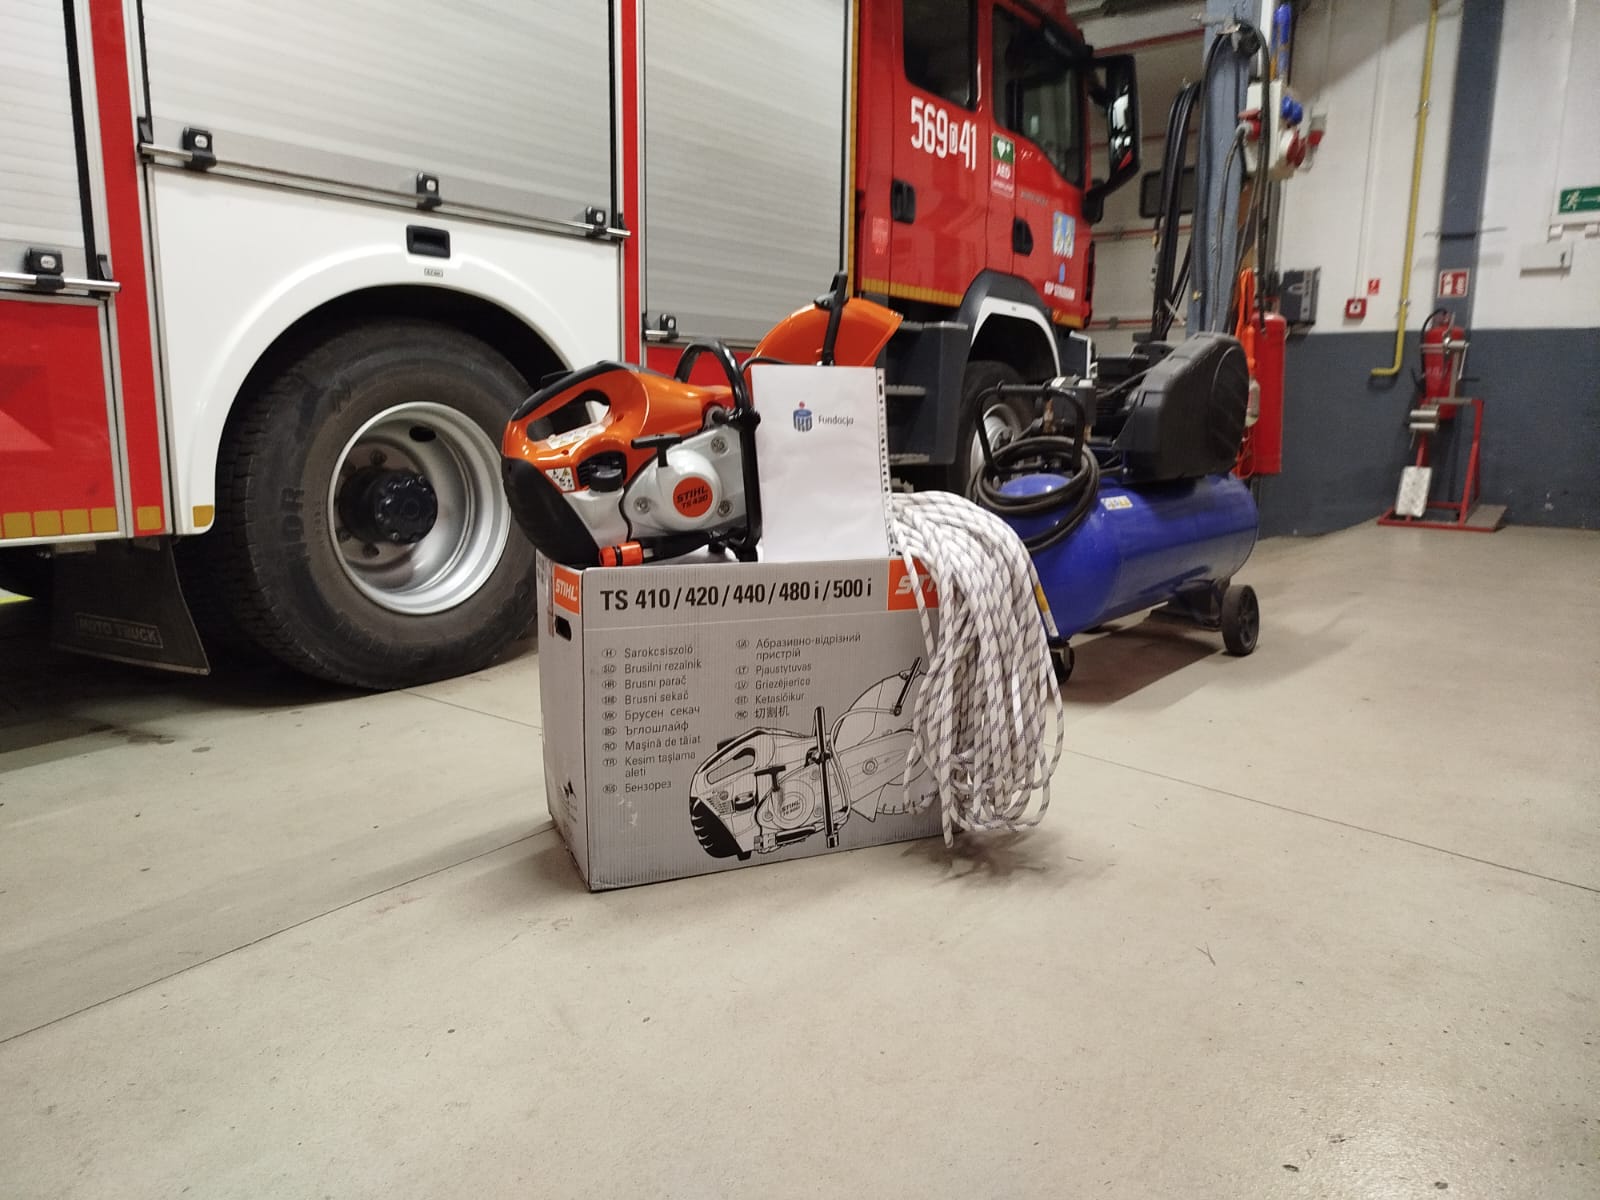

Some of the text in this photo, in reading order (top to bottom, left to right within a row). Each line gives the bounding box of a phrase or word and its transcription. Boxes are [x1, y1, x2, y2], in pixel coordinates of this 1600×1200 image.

[996, 163, 1011, 179] AED
[818, 415, 854, 426] Fundacja
[677, 486, 708, 503] STIHL
[555, 579, 578, 601] STIHL
[600, 590, 629, 611] TS
[624, 662, 662, 674] Brusilni
[664, 658, 702, 671] rezalnik
[624, 679, 656, 690] Brusni
[624, 693, 657, 705] Brusni
[670, 705, 700, 717] секач
[665, 737, 677, 748] de
[624, 755, 655, 767] Kesim
[625, 766, 646, 778] aleti
[624, 780, 672, 793] Бензорез
